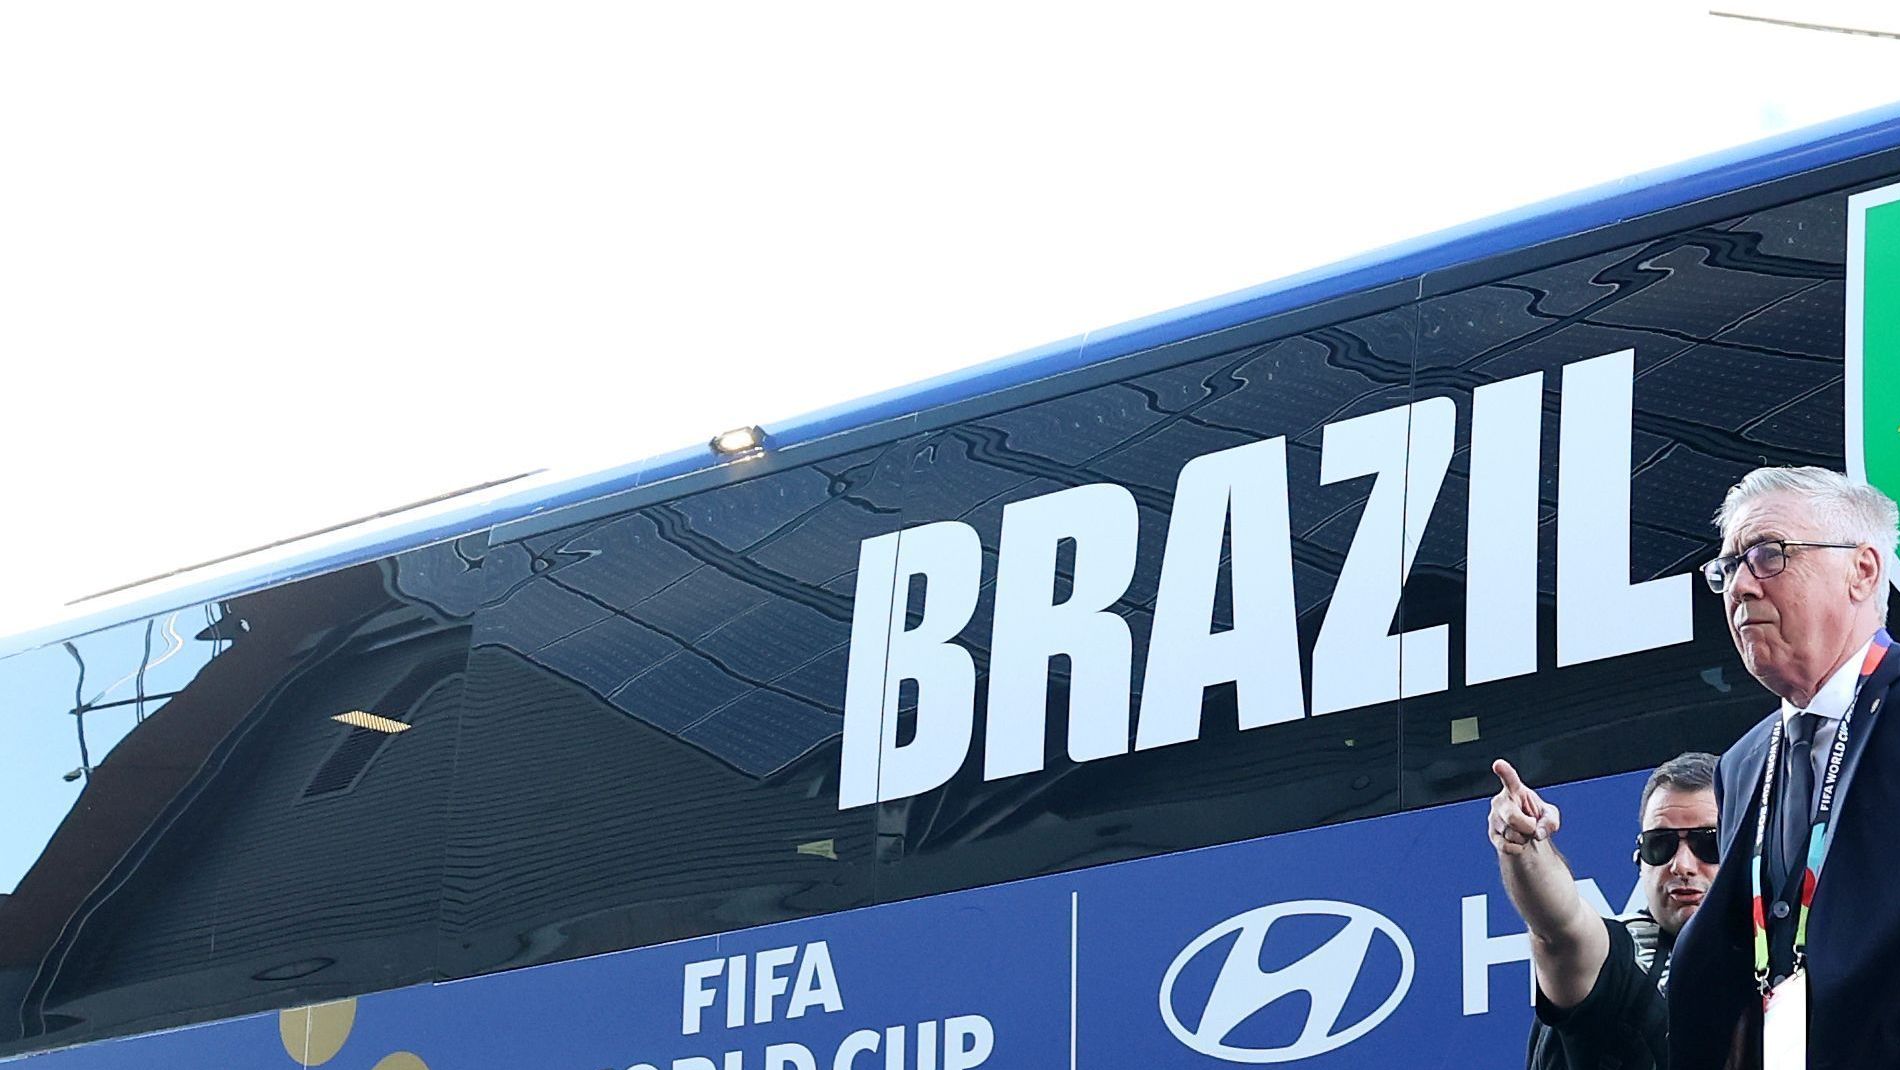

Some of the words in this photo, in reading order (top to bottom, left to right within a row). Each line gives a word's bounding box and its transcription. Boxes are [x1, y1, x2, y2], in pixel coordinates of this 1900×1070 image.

[838, 348, 1694, 811] BRAZIL
[1825, 741, 1847, 784] WORLD
[1820, 785, 1834, 811] FIFA
[682, 940, 844, 1035] FIFA
